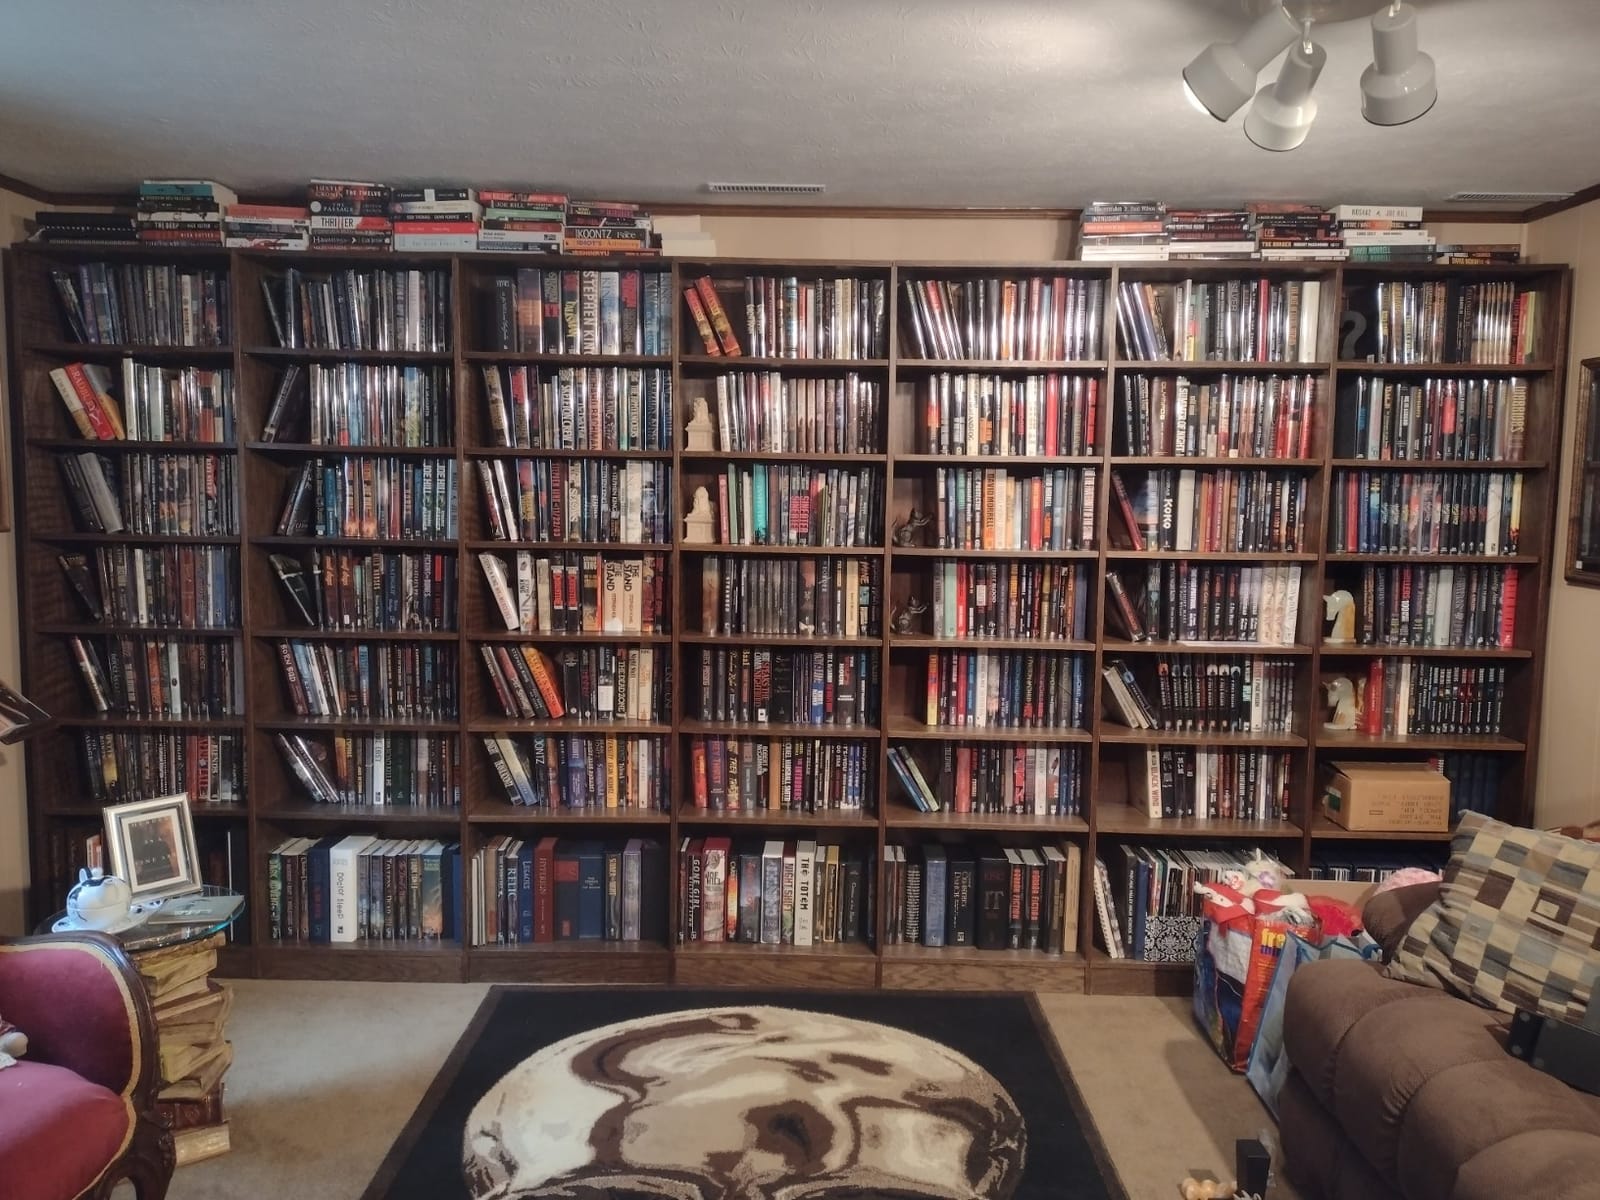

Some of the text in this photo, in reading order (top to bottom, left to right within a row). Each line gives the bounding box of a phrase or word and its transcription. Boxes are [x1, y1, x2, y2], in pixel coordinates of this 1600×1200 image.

[577, 229, 612, 239] KOONTZ
[582, 271, 594, 326] STEPHEN
[1163, 499, 1174, 529] KOKO
[606, 564, 615, 592] STAND
[624, 564, 632, 592] STAND
[784, 864, 794, 913] NIGHT SHIFT
